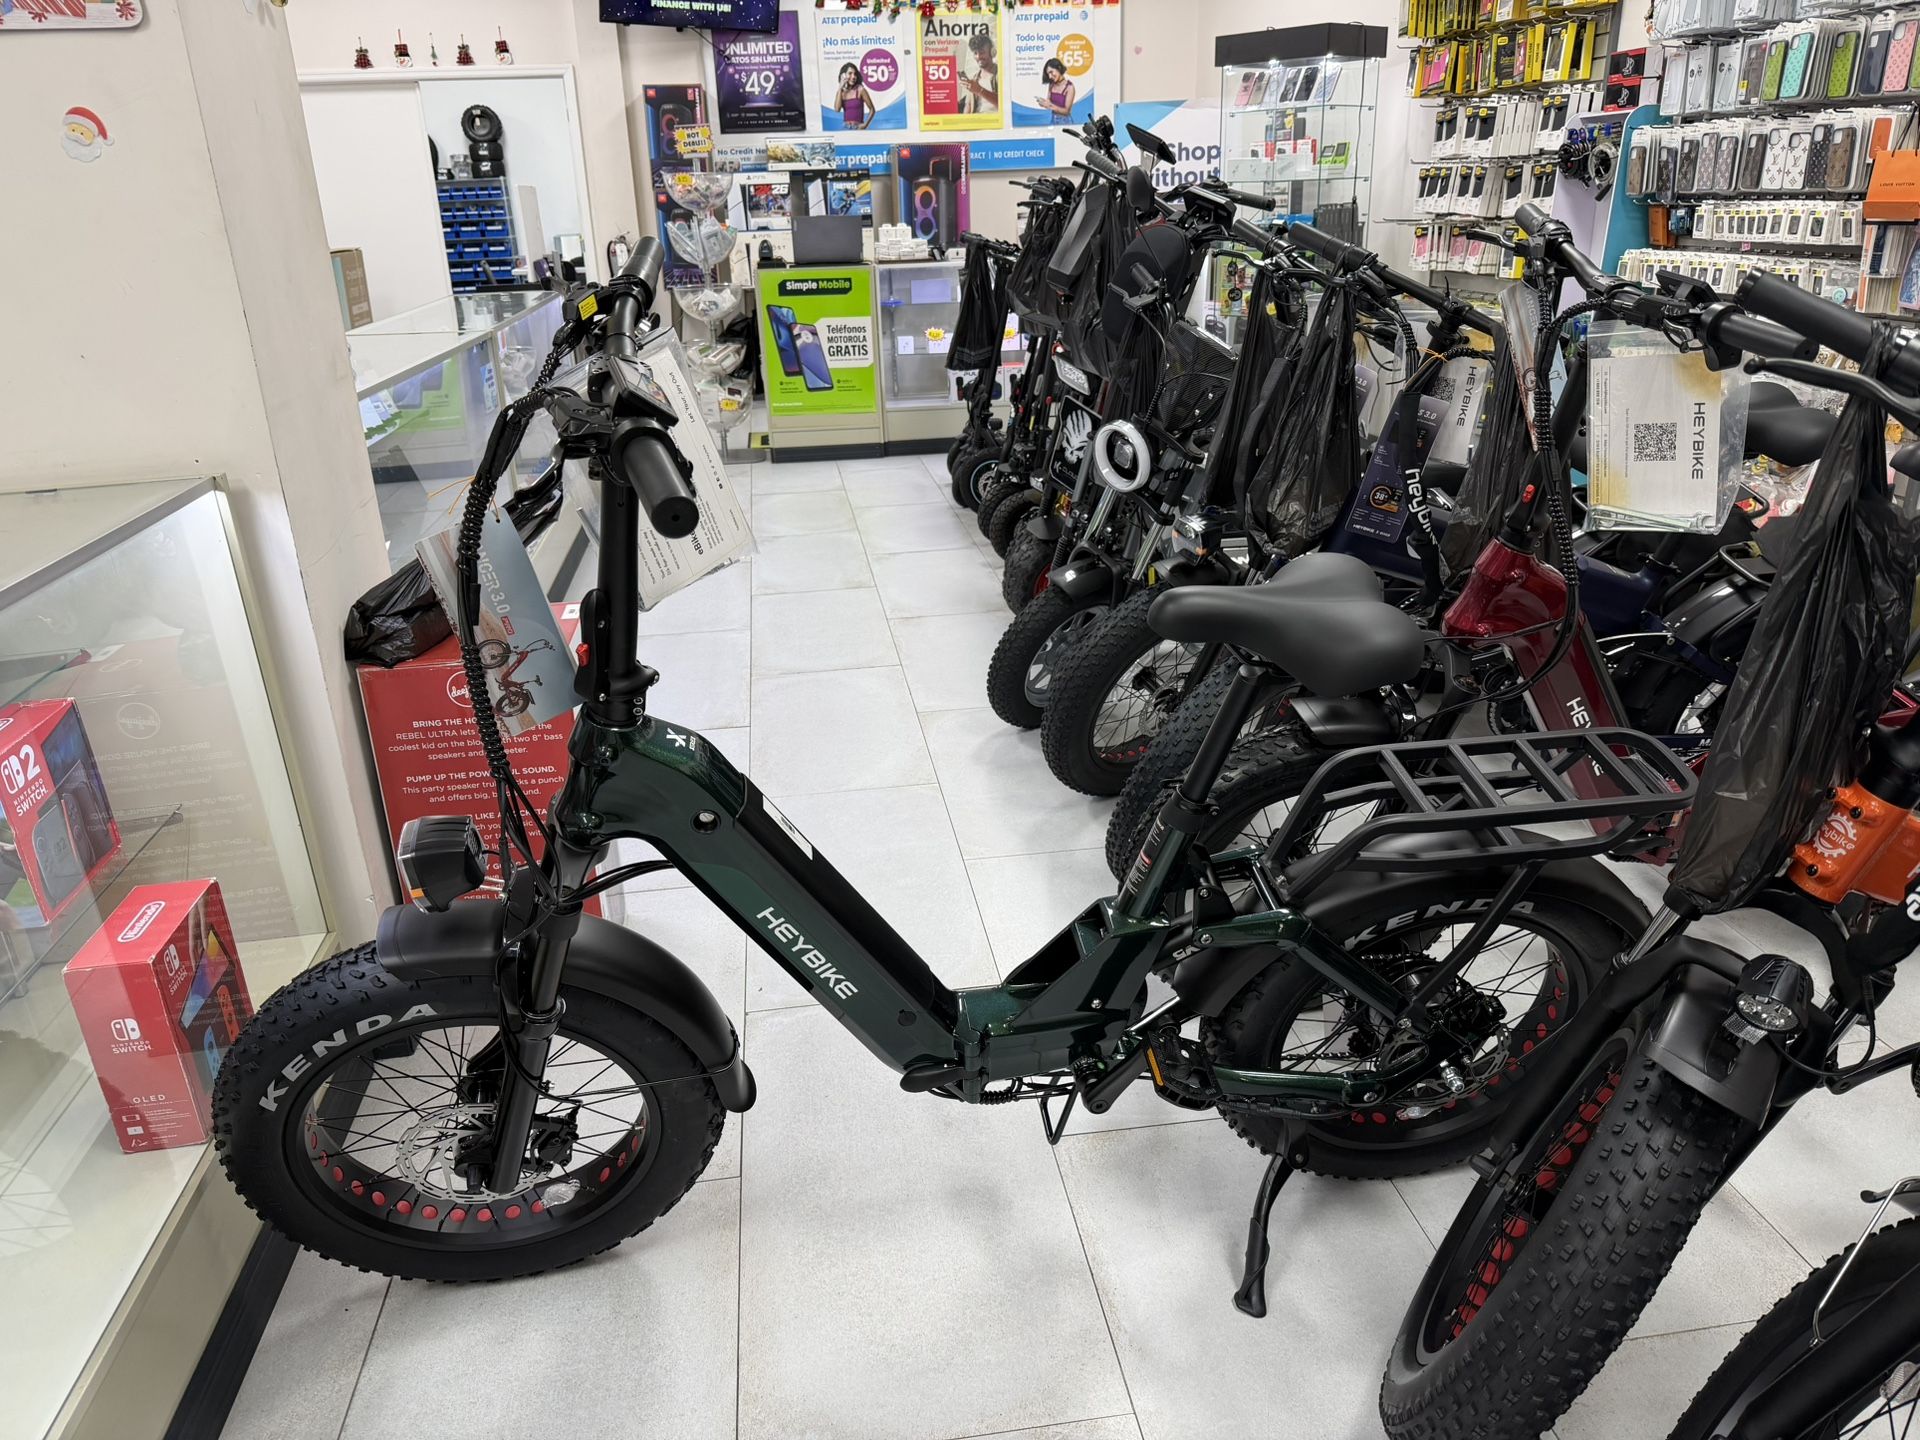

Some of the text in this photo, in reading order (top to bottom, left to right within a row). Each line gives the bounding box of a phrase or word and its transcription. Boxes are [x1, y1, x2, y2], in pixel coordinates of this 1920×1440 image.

[651, 0, 731, 13] FINANCE WITH US!
[841, 13, 877, 26] prepaid
[1033, 11, 1069, 23] prepaid
[924, 19, 990, 37] Ahorra
[822, 35, 895, 48] ¡No más límites!
[1016, 33, 1035, 42] Todo
[1046, 34, 1060, 43] que
[721, 41, 793, 55] UNLIMITED
[1016, 43, 1045, 52] quieres
[725, 55, 749, 64] ATOS
[750, 55, 762, 63] SIN
[1059, 51, 1084, 67] $65
[863, 65, 889, 82] $50
[925, 65, 950, 80] $50
[741, 71, 775, 95] $49
[686, 131, 700, 139] HOT
[969, 151, 986, 160] RACT
[1003, 150, 1024, 159] CREDIT
[1025, 149, 1045, 158] CHECK
[786, 279, 850, 291] Simple Mobile
[827, 324, 867, 335] Teléfonos
[827, 335, 867, 344] MOTOROLA
[828, 344, 868, 357] GRATIS
[667, 371, 678, 385] Out
[1456, 366, 1478, 427] HEYBIKE
[1424, 410, 1437, 420] 3.0
[1691, 402, 1706, 480] HEYBIKE
[491, 592, 511, 614] 3.0
[450, 683, 471, 698] deej
[412, 720, 442, 728] BRING
[444, 718, 462, 726] THE
[395, 732, 426, 740] REBEL
[427, 729, 458, 738] ULTRA
[388, 743, 420, 752] coolest
[421, 742, 435, 750] kid
[467, 738, 484, 746] blo
[427, 752, 466, 760] speakers
[467, 749, 484, 757] and
[406, 774, 432, 783] PUMP
[433, 773, 447, 781] UP
[448, 772, 466, 780] THE
[522, 765, 556, 774] SOUND.
[402, 786, 420, 795] This
[422, 784, 445, 794] party
[446, 782, 480, 792] speaker
[538, 775, 565, 785] punch
[13, 778, 45, 807] NINTENDO
[429, 795, 446, 803] and
[447, 793, 472, 801] offers
[15, 784, 48, 817] SWITCH
[475, 812, 495, 820] LIKE
[1821, 824, 1856, 851] ybike
[122, 903, 161, 940] Nintendo
[755, 905, 860, 1000] HEYBIKE
[169, 970, 188, 996] SWITCH
[110, 1040, 151, 1049] NINTENDO
[112, 1044, 152, 1055] SWITCH
[258, 1003, 439, 1112] KENDA
[132, 1094, 166, 1104] OLED
